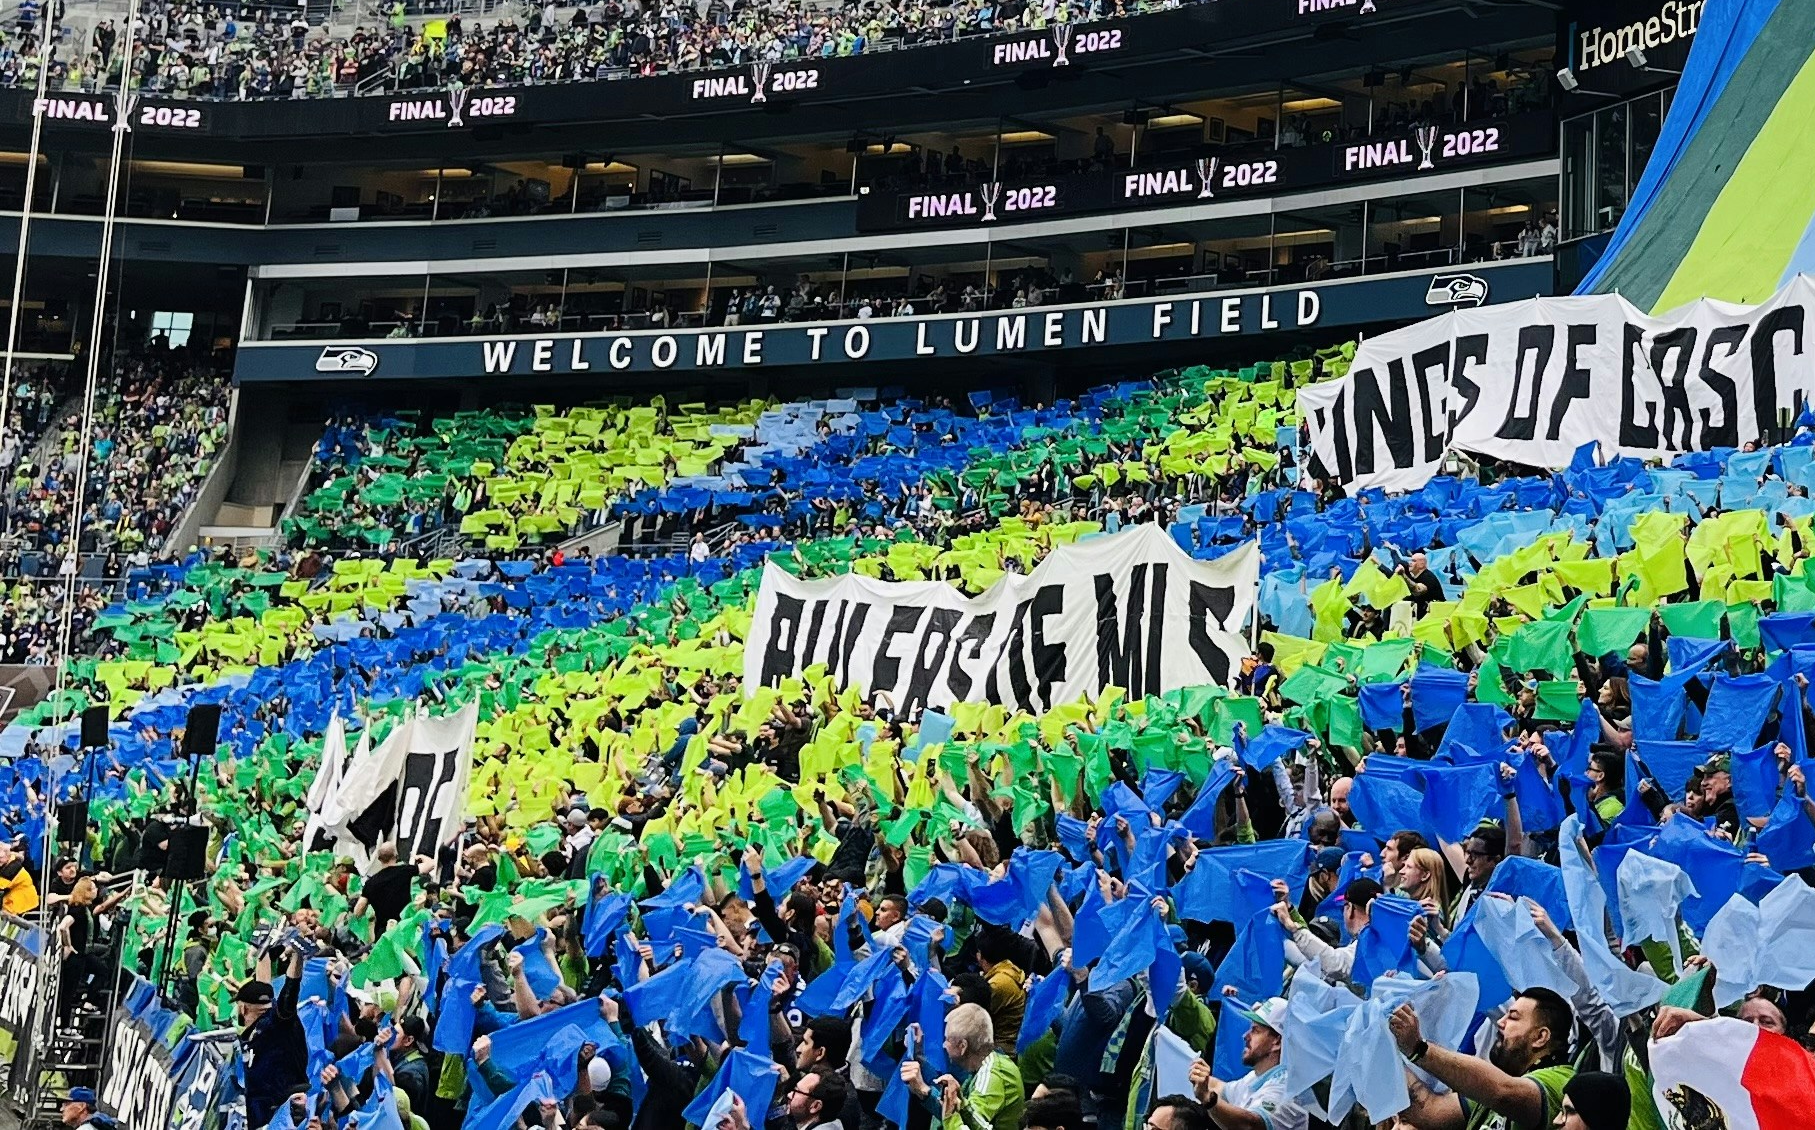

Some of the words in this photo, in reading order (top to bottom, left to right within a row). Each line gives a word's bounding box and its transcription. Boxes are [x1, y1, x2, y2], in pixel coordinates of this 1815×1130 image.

[994, 39, 1050, 65] FINAL
[1074, 29, 1122, 54] 2022
[692, 75, 749, 99] FINAL
[772, 69, 819, 92] 2022
[32, 98, 109, 122] FINAL
[140, 106, 201, 128] 2022
[389, 99, 446, 121] FINAL
[469, 96, 516, 117] 2022
[1345, 141, 1413, 171] FINAL
[1442, 127, 1499, 158] 2022
[1125, 170, 1193, 198] FINAL
[1222, 160, 1278, 188] 2022
[908, 192, 977, 219] FINAL
[1005, 186, 1057, 211] 2022
[483, 331, 763, 373] WELCOME
[808, 326, 871, 362] TO
[915, 307, 1108, 357] LUMEN
[1153, 290, 1321, 338] FIELD
[1499, 323, 1598, 441] OF
